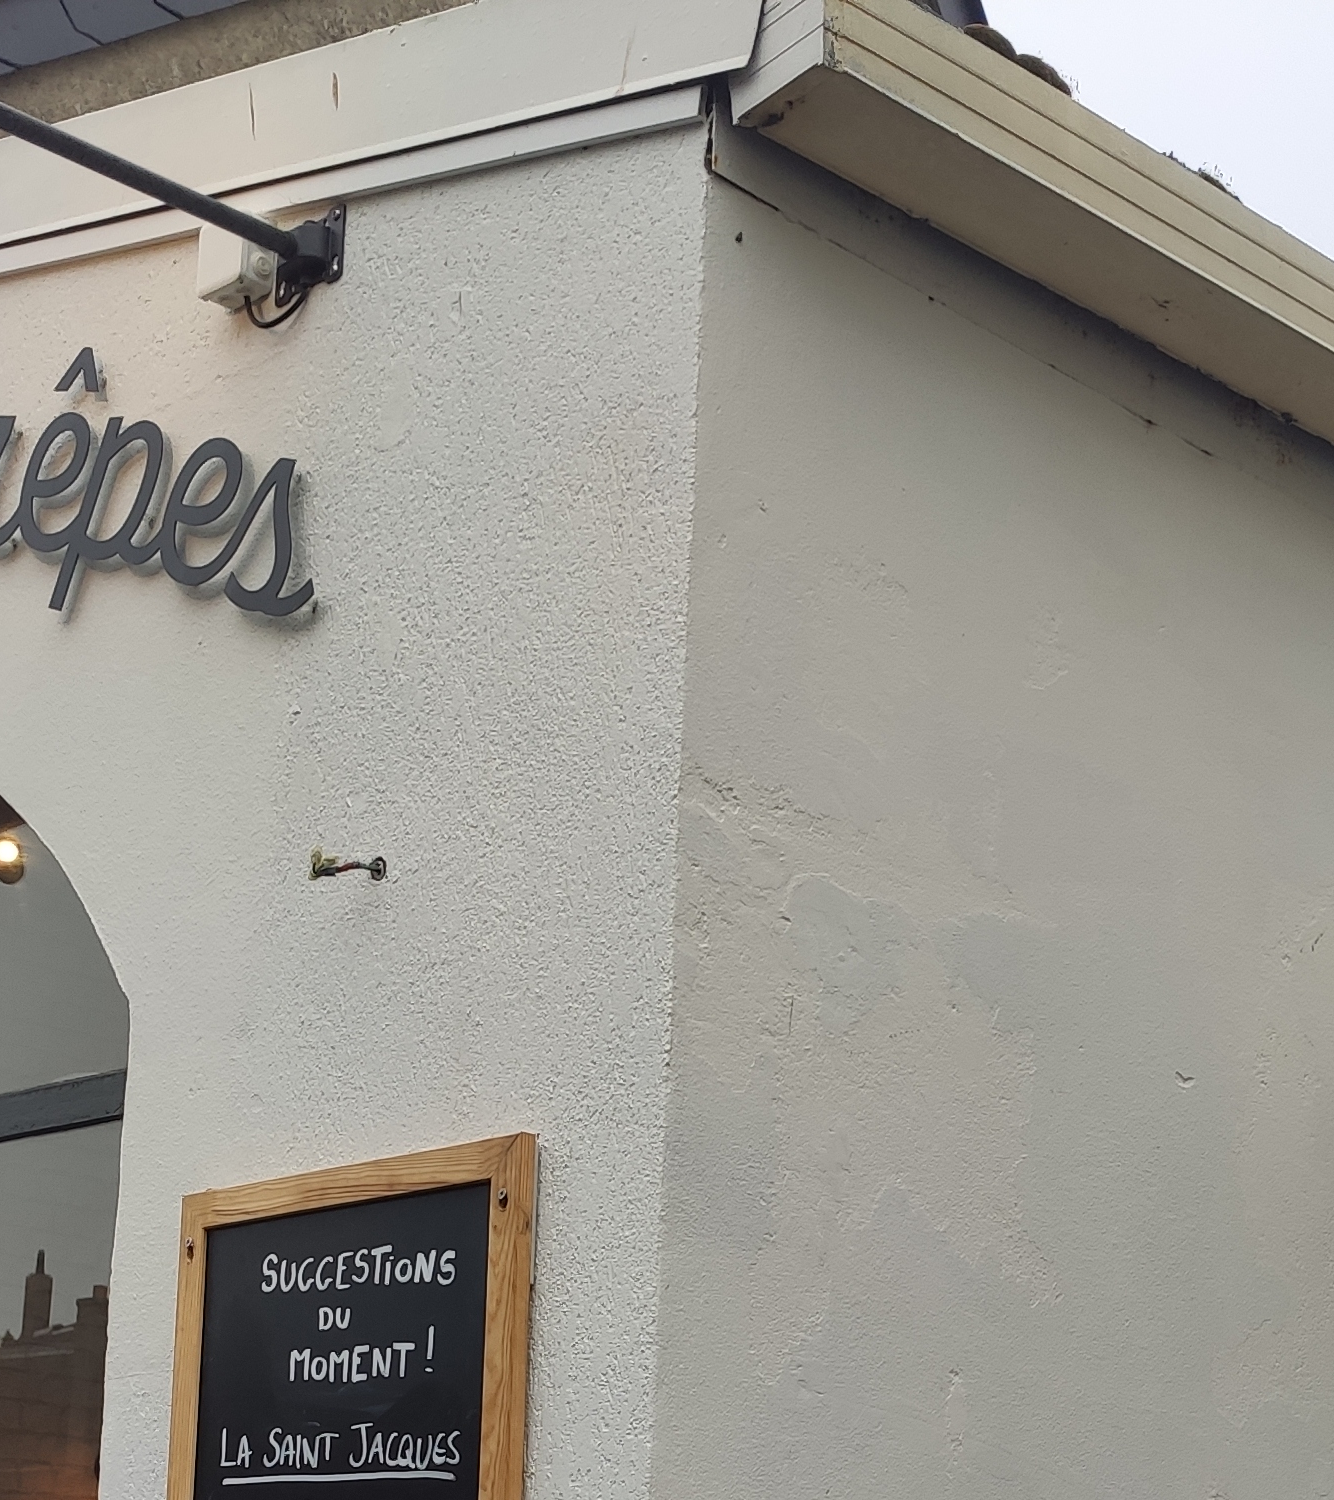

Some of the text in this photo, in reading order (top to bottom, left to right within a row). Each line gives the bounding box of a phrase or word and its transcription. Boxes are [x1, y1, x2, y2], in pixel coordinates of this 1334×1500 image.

[318, 1307, 351, 1331] DU
[289, 1342, 416, 1383] MOMENT
[220, 1423, 461, 1469] LA SAINT JACQUES
